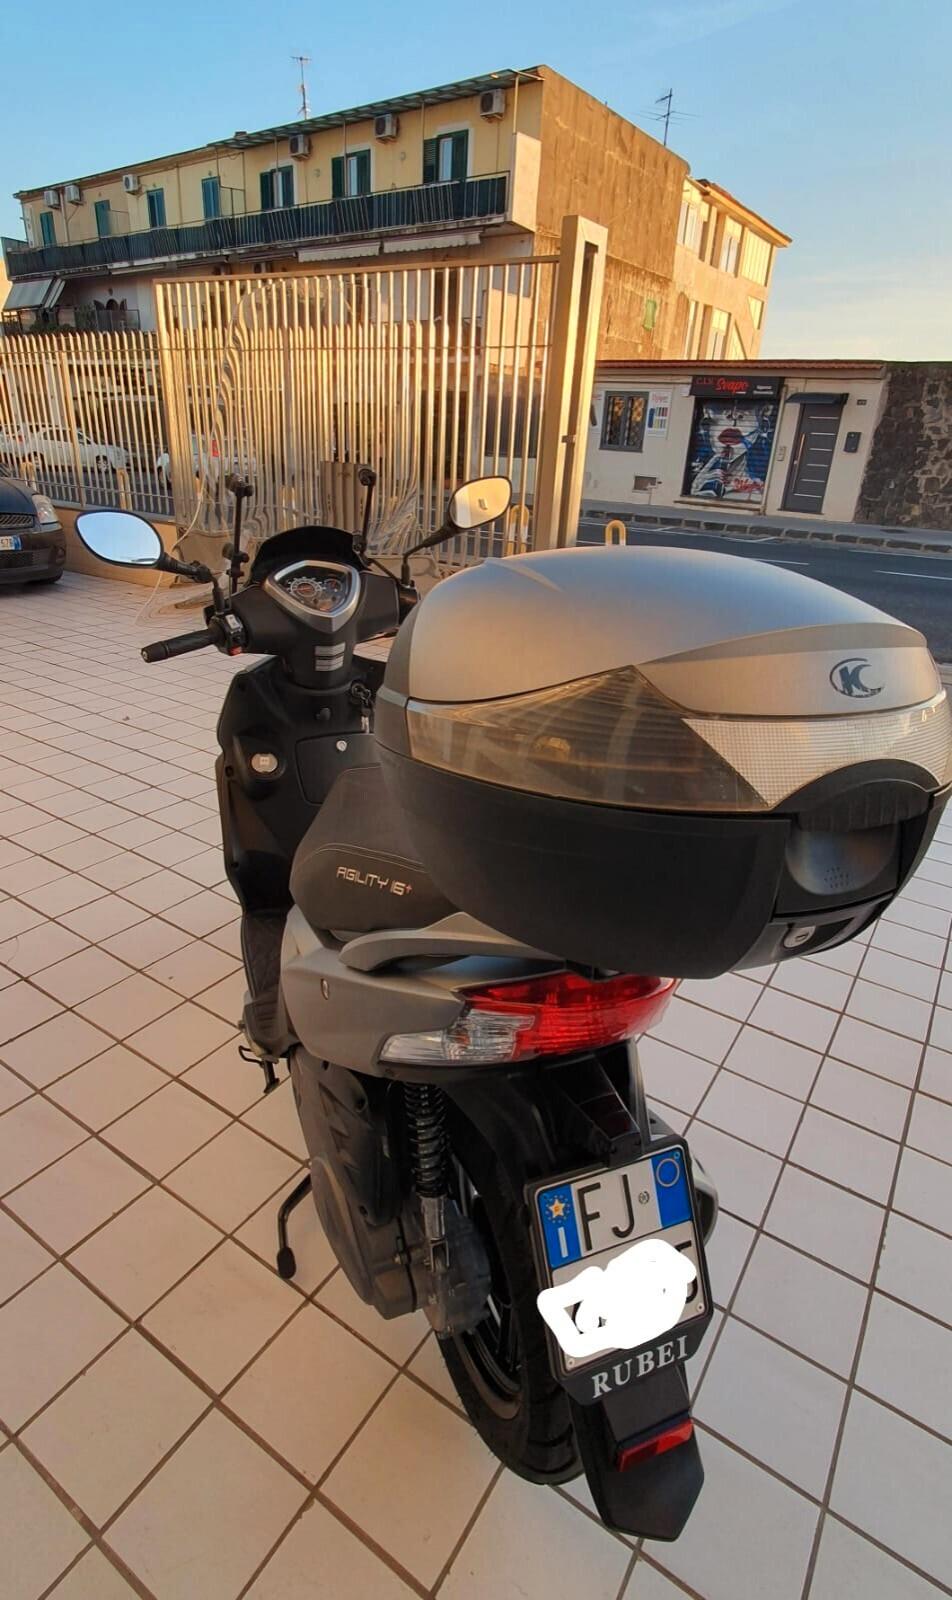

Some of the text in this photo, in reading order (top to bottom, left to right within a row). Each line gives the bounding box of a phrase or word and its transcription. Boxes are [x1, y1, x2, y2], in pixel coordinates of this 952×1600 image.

[336, 866, 389, 889] AGILITY
[577, 1173, 635, 1251] FJ
[591, 1335, 688, 1399] RUBEI
